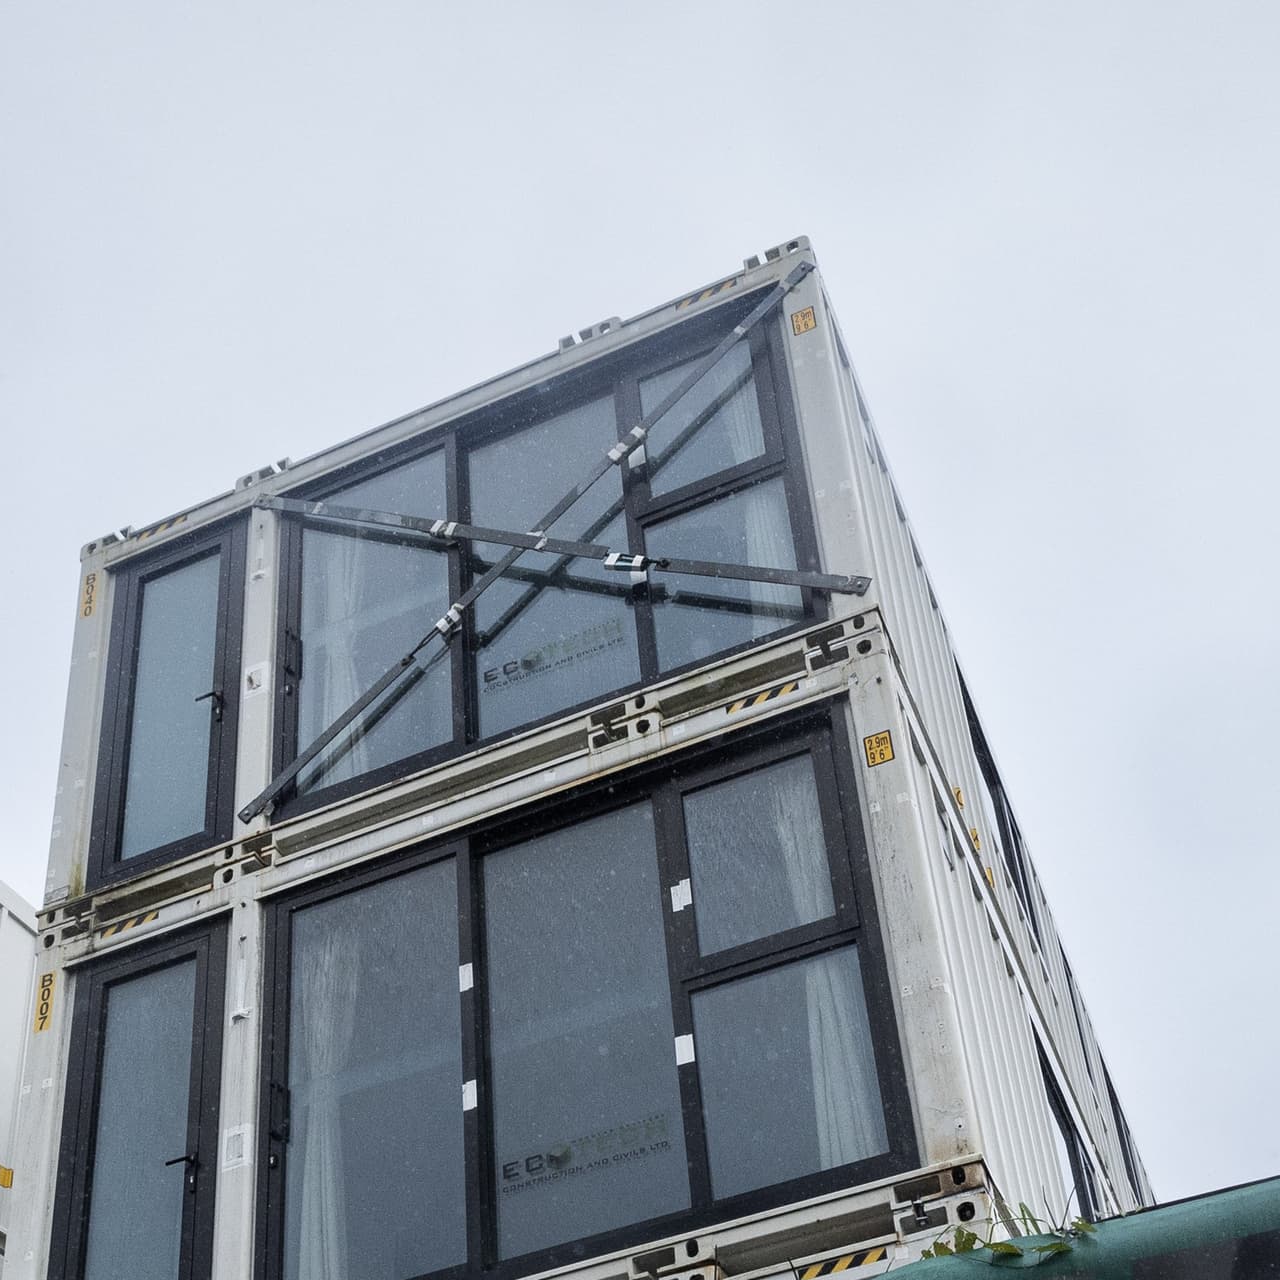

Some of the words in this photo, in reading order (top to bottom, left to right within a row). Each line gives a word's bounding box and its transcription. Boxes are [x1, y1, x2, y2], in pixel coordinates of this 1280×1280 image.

[867, 736, 888, 751] 2.9m
[38, 973, 54, 1031] B007
[502, 1165, 583, 1194] CONSTRUCTION
[586, 1158, 609, 1169] AND
